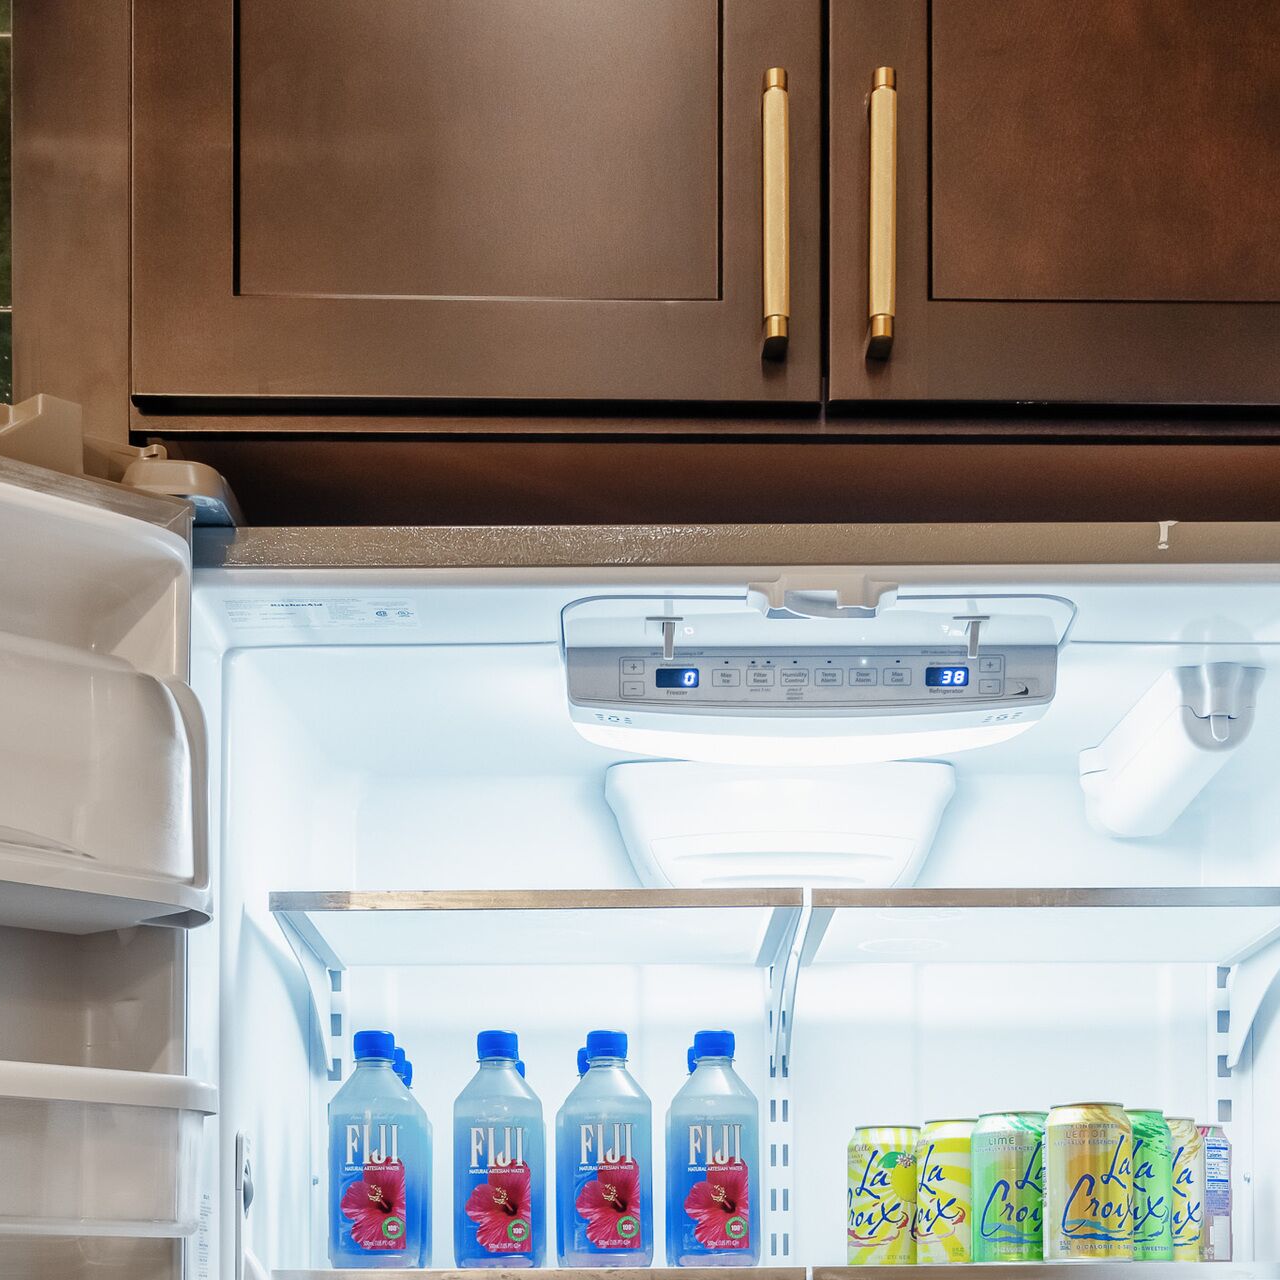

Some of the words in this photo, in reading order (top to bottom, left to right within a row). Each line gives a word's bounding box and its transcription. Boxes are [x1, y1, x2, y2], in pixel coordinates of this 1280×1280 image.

[684, 671, 696, 686] 0
[942, 670, 966, 684] 38
[345, 1124, 399, 1165] FIJI
[470, 1126, 524, 1168] FIJI
[580, 1122, 634, 1165] FIJI
[688, 1124, 742, 1166] FIJI
[1066, 1130, 1106, 1138] LEMON
[856, 1150, 891, 1199] La
[919, 1144, 946, 1195] La
[1101, 1134, 1132, 1189] La
[981, 1179, 1042, 1237] Croi
